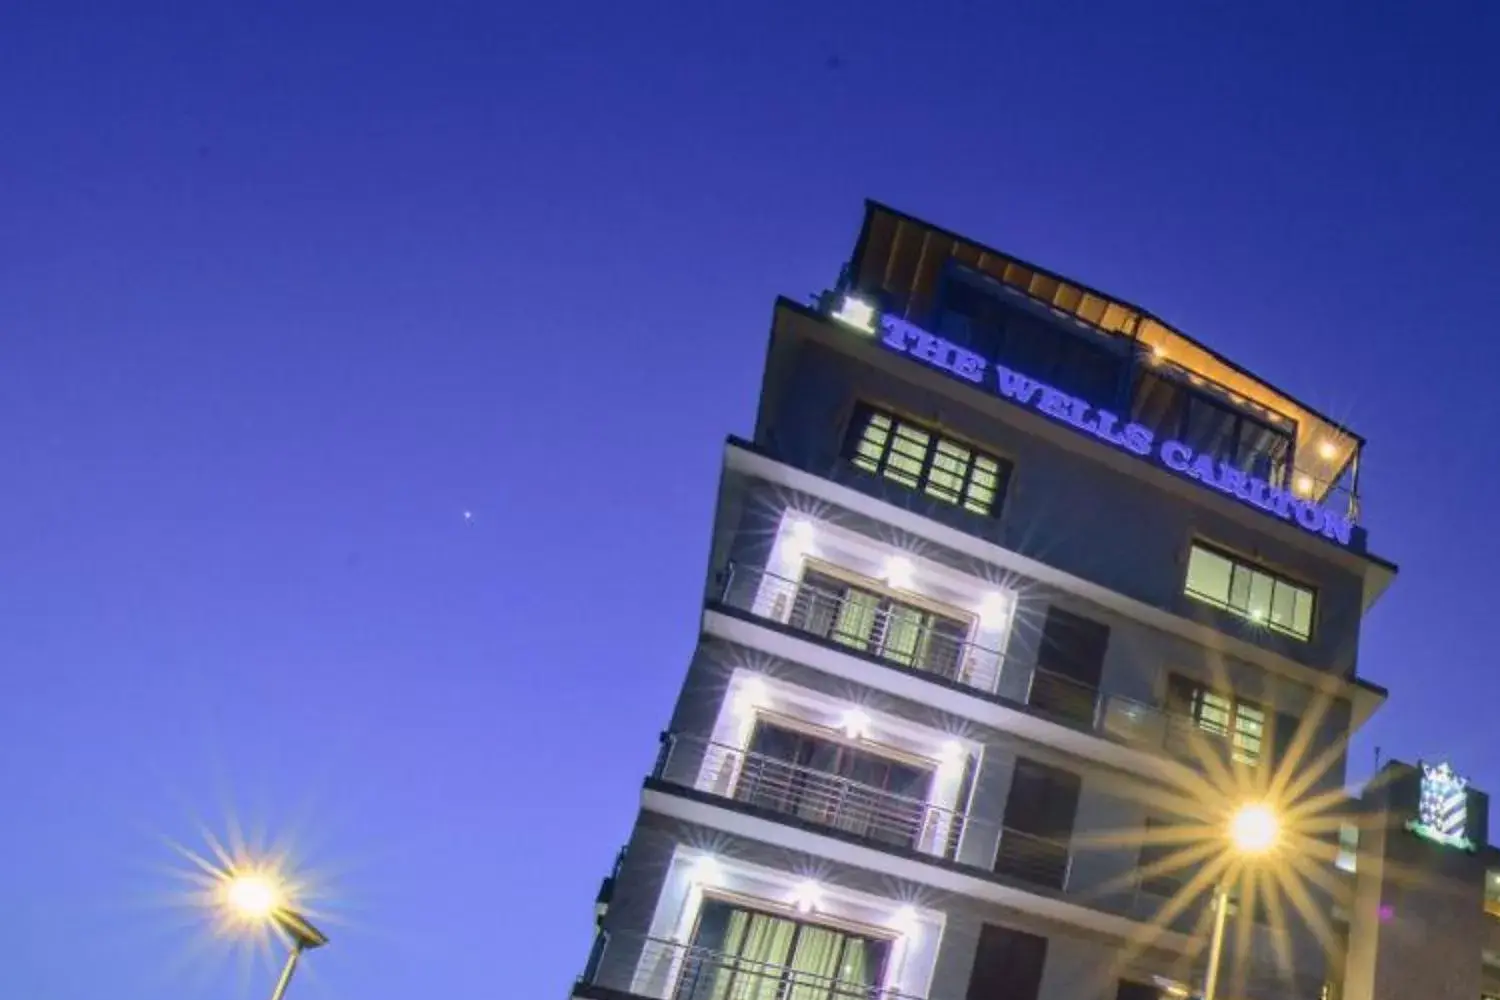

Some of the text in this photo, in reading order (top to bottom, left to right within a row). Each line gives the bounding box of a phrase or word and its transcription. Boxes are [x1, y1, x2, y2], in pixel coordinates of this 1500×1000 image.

[881, 315, 1354, 544] THE WELLS CARLTON
